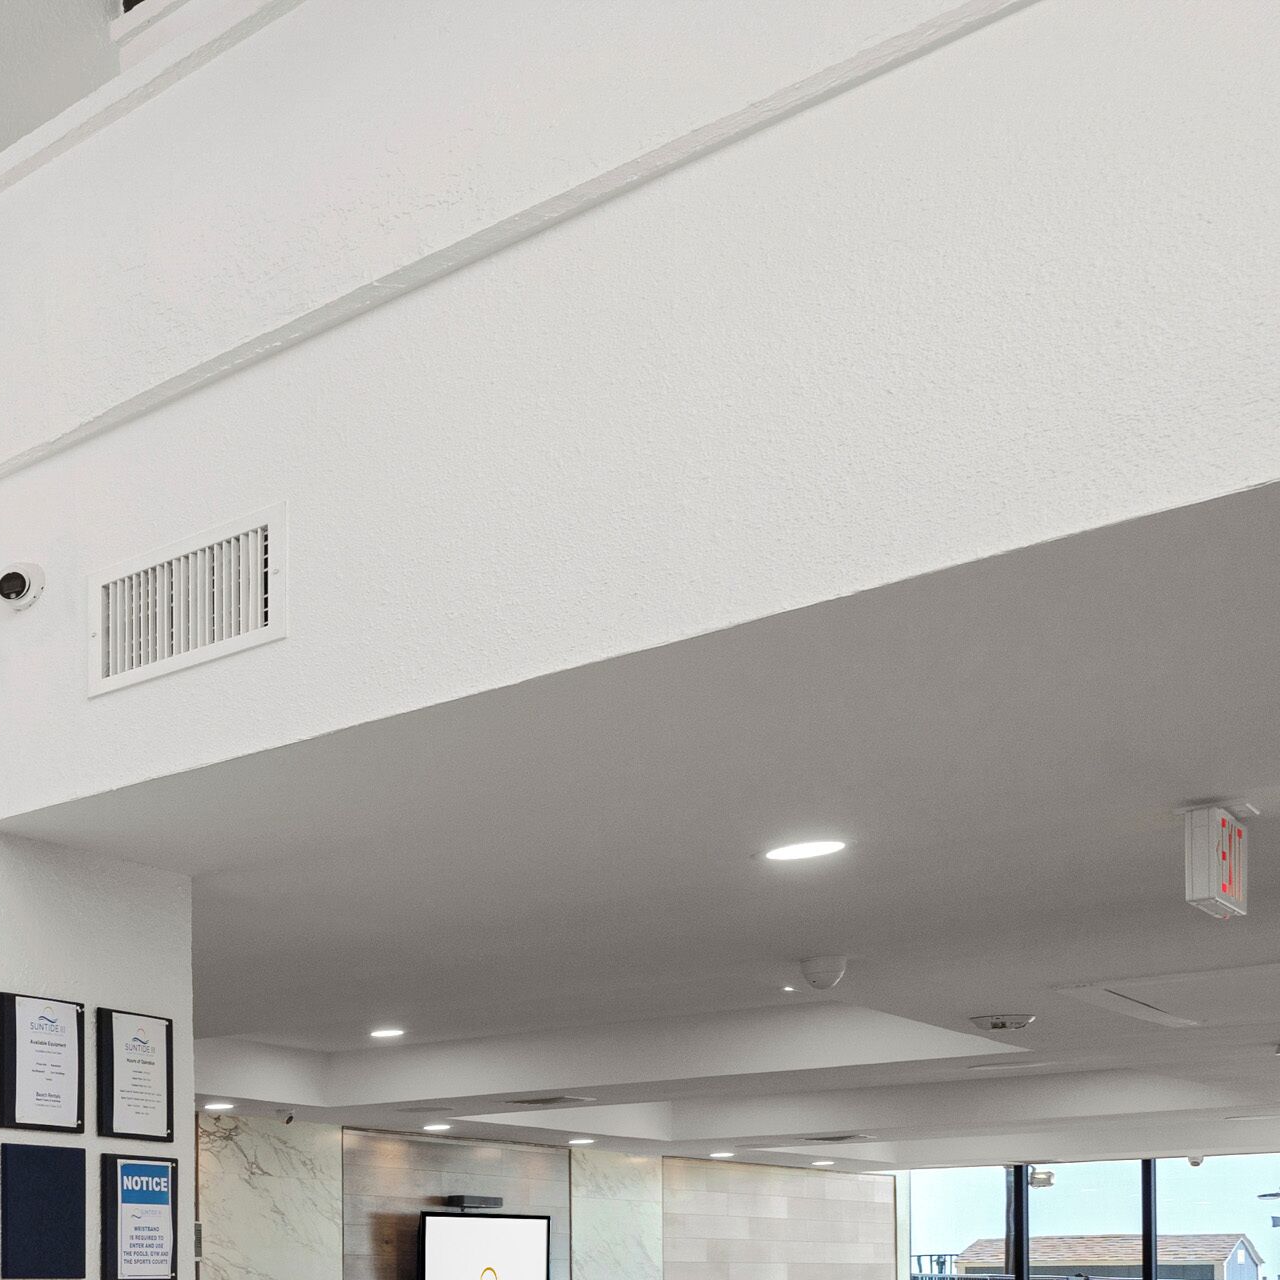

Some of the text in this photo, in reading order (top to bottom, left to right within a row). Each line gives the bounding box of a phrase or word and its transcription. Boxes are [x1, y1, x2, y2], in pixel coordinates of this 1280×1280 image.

[30, 1022, 59, 1033] SUNTIDE
[125, 1043, 150, 1054] SUNTIDE
[123, 1175, 168, 1192] NOTICE
